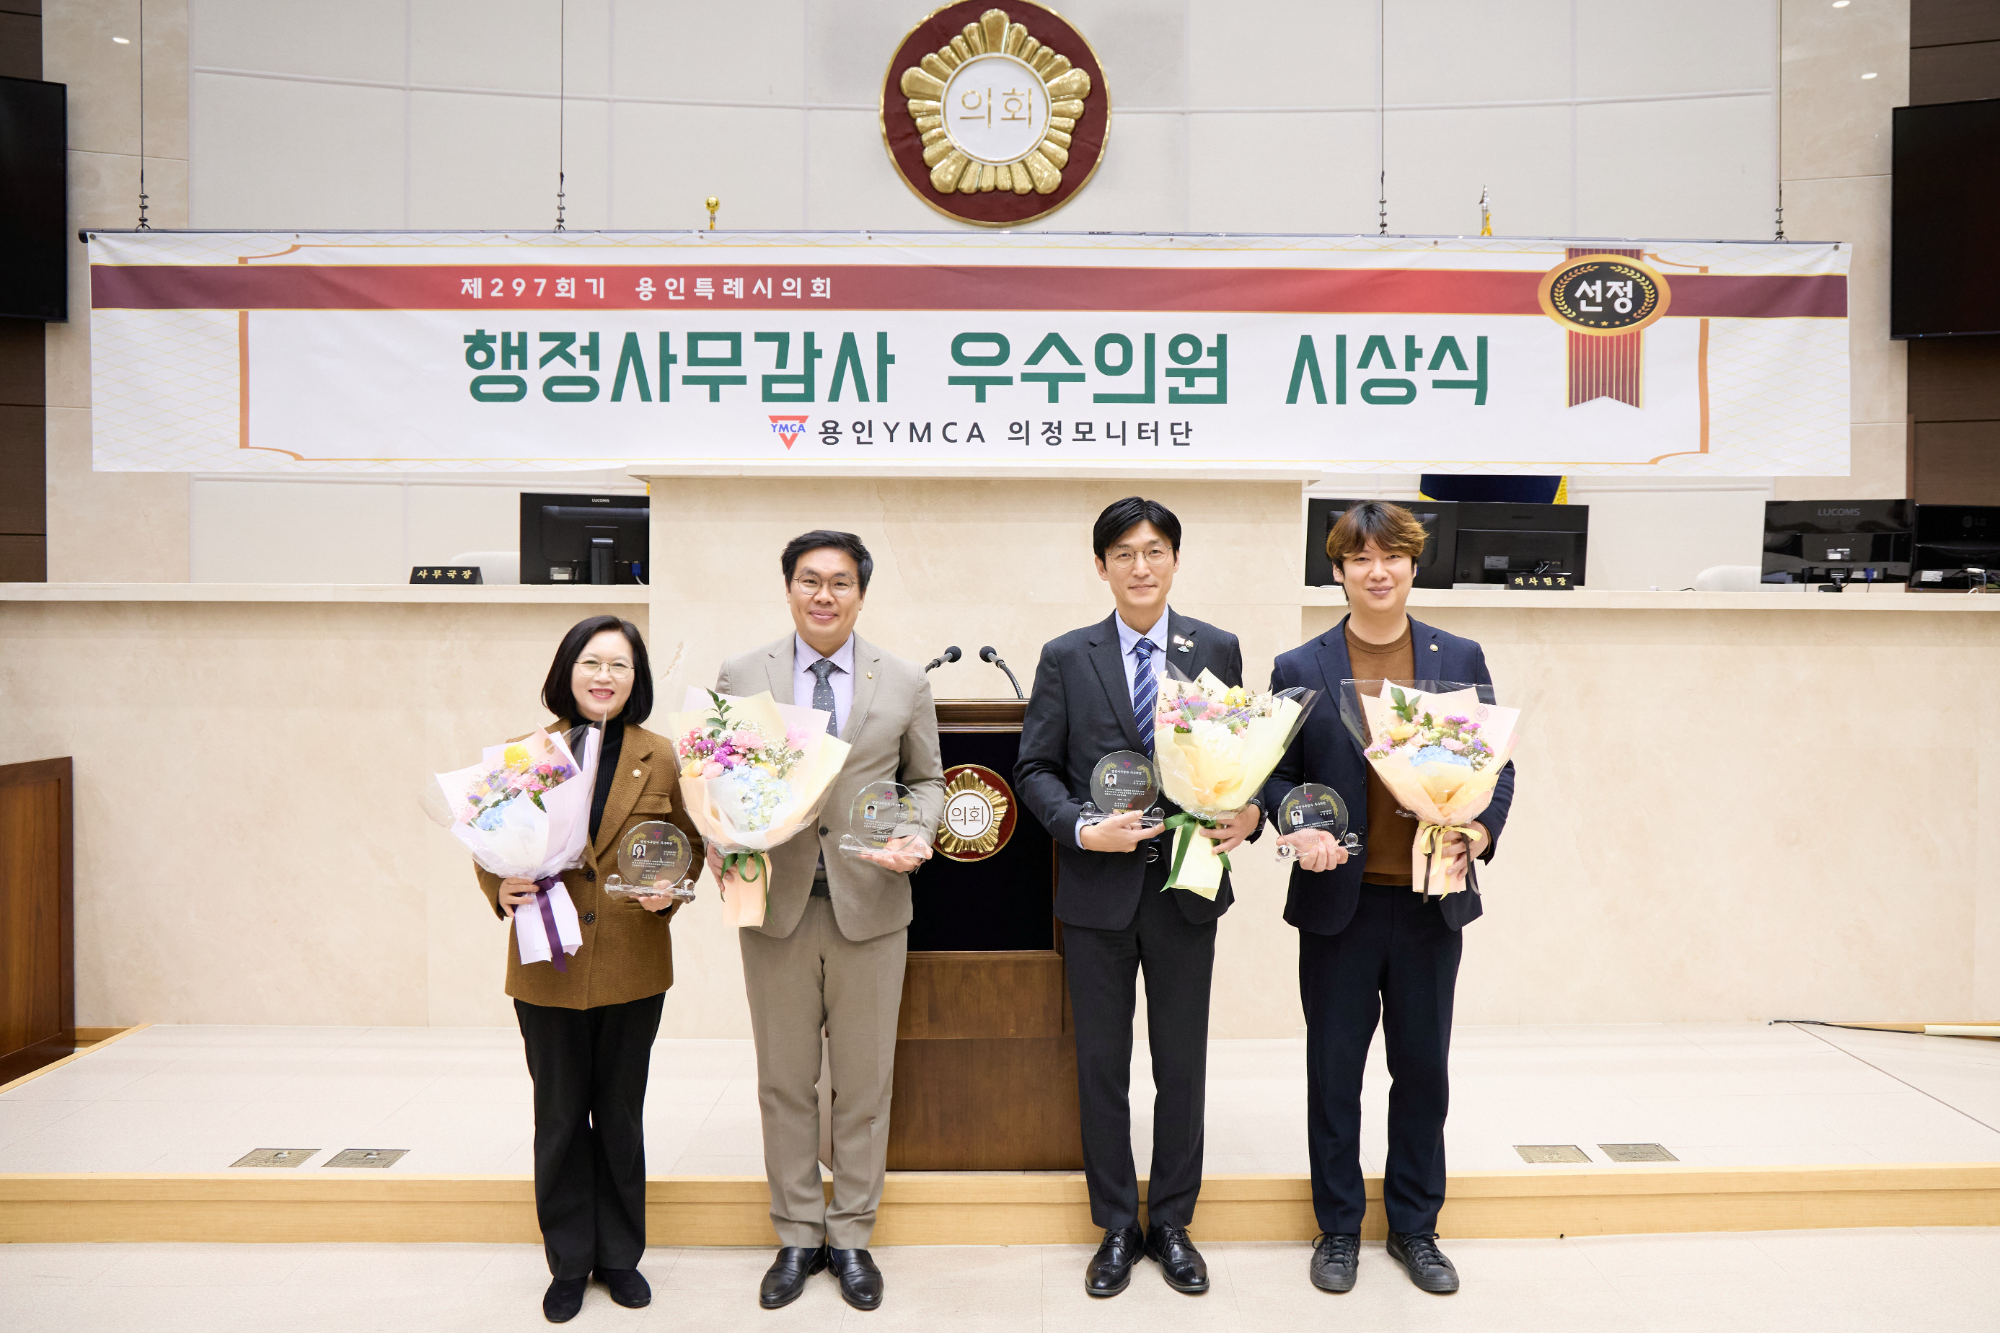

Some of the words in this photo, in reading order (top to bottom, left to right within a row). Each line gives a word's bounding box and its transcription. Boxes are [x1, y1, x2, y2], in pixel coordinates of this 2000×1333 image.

[959, 87, 1032, 129] 의회
[460, 277, 606, 300] 제297회기
[634, 276, 832, 301] 용인특례시의회
[1574, 280, 1633, 314] 선정
[463, 328, 896, 403] 행정사무감사
[947, 331, 1228, 404] 우수의원
[1285, 334, 1489, 406] 시상식
[770, 423, 806, 433] YMCA
[818, 419, 986, 446] 용인YMCA
[1007, 420, 1193, 447] 의정모니터단
[1817, 508, 1861, 517] LUCOMS
[416, 569, 473, 580] 사무국장
[950, 805, 984, 826] 의회
